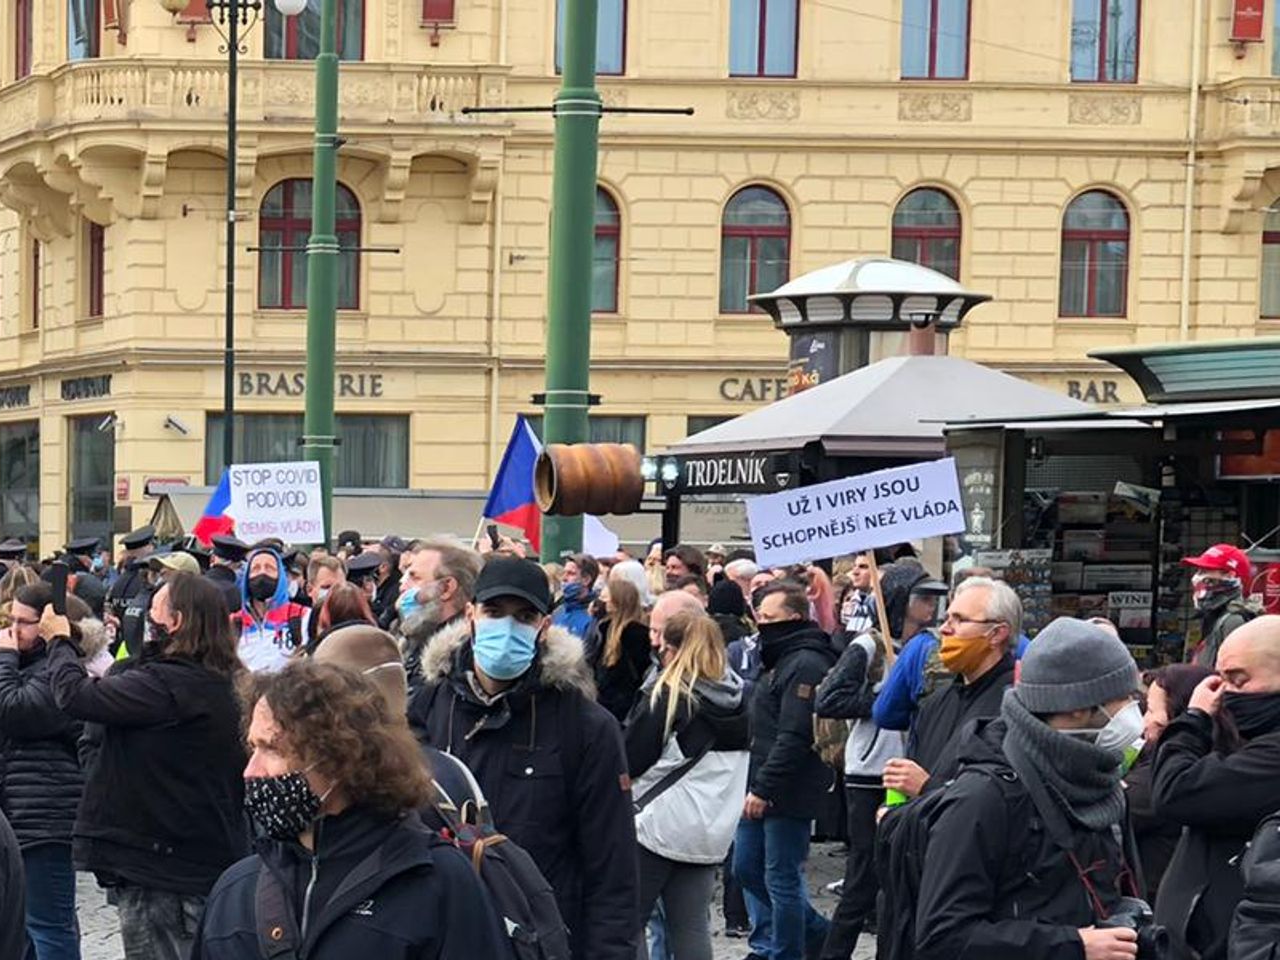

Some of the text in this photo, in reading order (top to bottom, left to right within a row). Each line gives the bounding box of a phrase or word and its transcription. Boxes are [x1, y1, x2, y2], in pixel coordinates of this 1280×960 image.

[238, 372, 384, 397] BRASRIE
[1067, 380, 1120, 403] BAR
[232, 468, 318, 487] STOP COVID
[685, 452, 767, 487] TRDELNÍK
[246, 490, 307, 509] PODVOD
[787, 476, 921, 517] UŽ I VIRY JSOU
[762, 499, 960, 550] SCHOPNĚJŠÍ NEŽ VLÁDA
